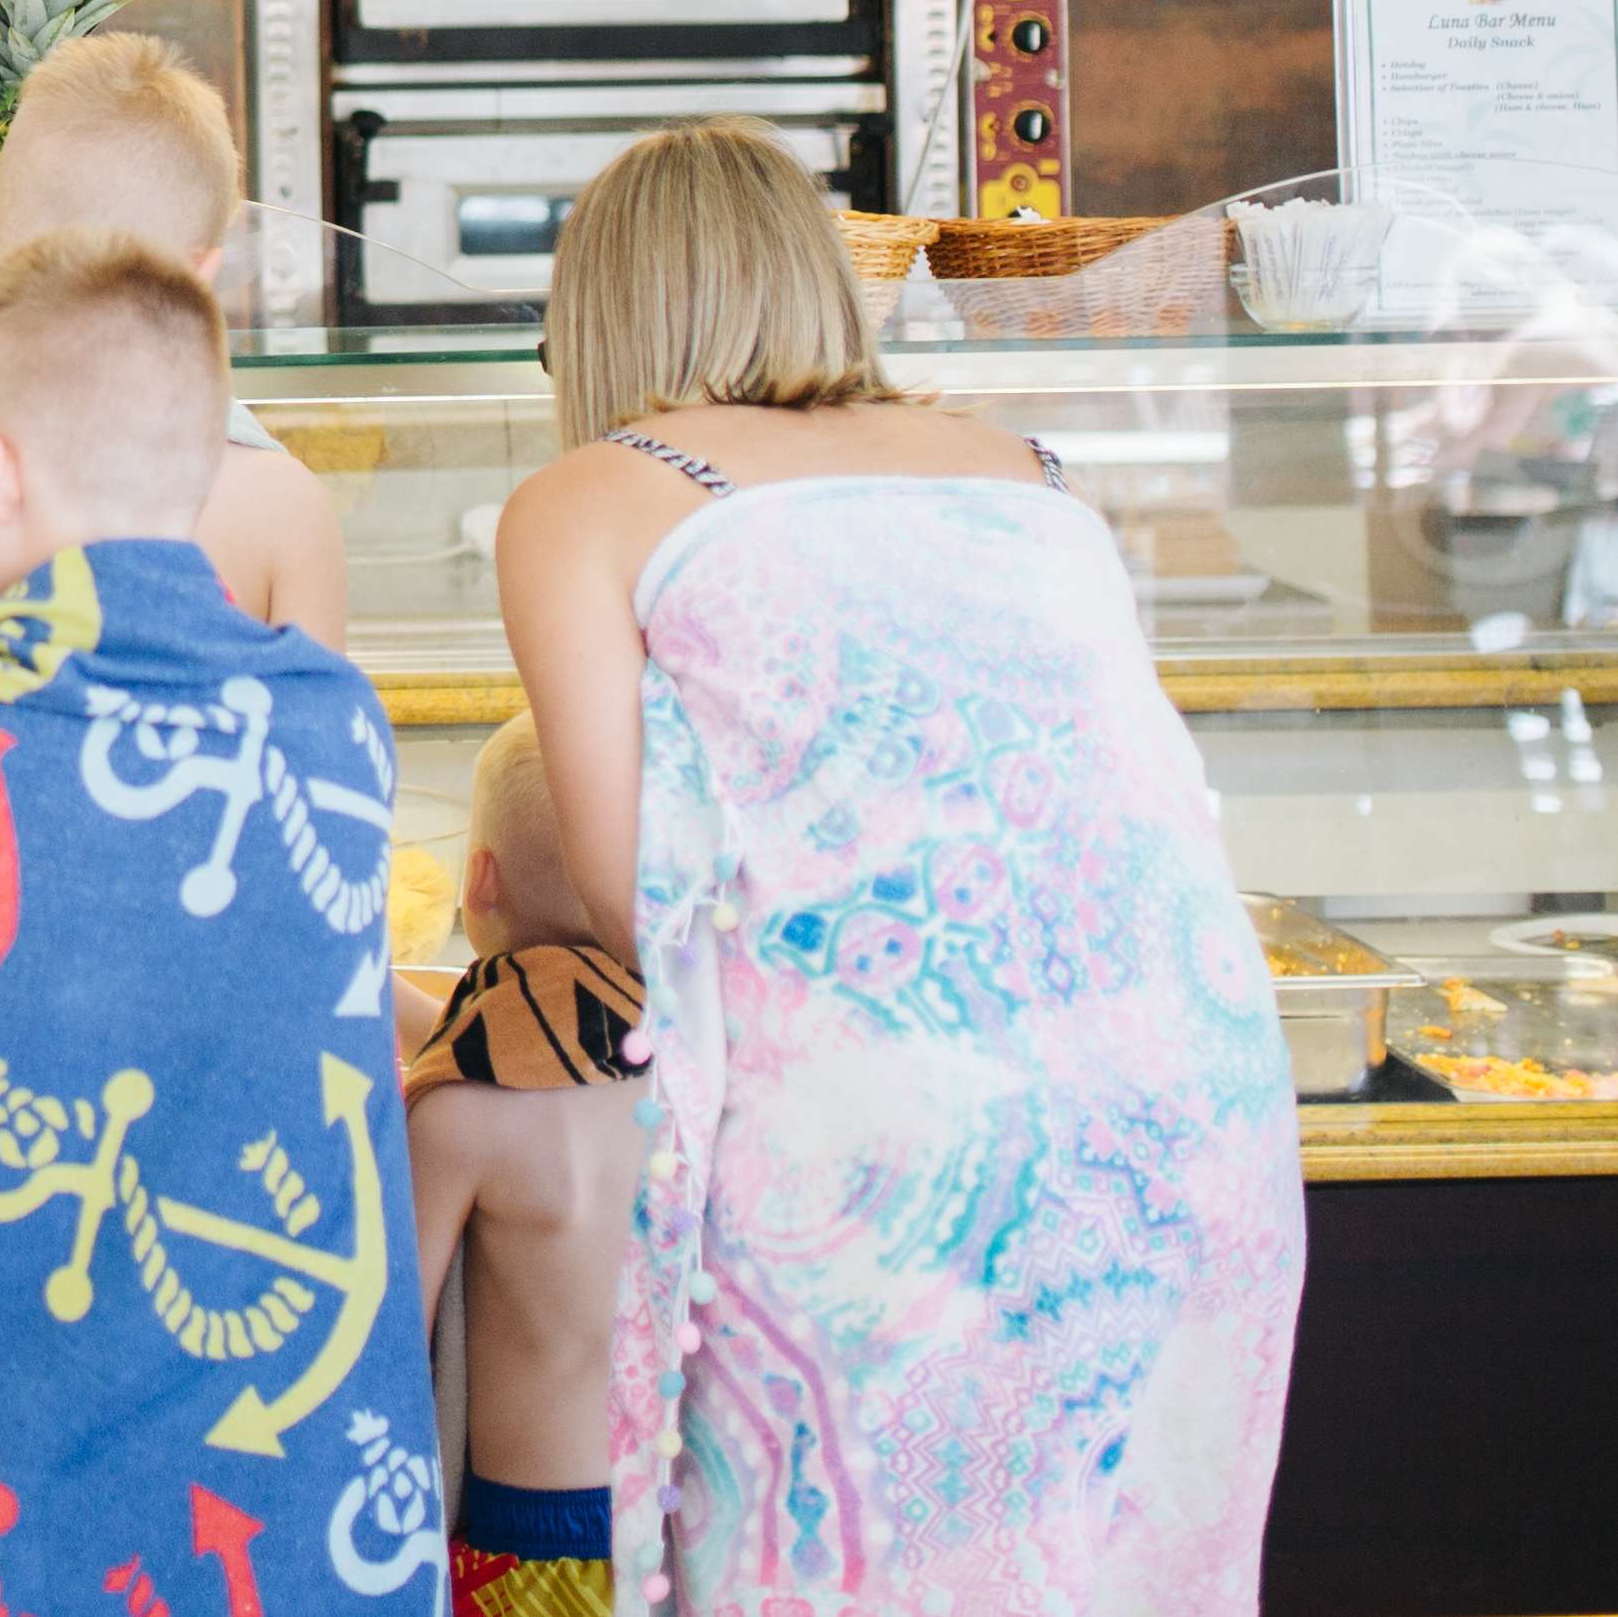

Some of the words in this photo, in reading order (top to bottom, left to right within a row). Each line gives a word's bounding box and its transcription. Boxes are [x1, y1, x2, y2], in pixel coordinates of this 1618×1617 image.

[1427, 14, 1470, 31] Luna
[1475, 13, 1506, 29] Bar
[1509, 13, 1557, 28] Menu
[1447, 36, 1487, 51] Daily
[1490, 35, 1536, 49] Snack
